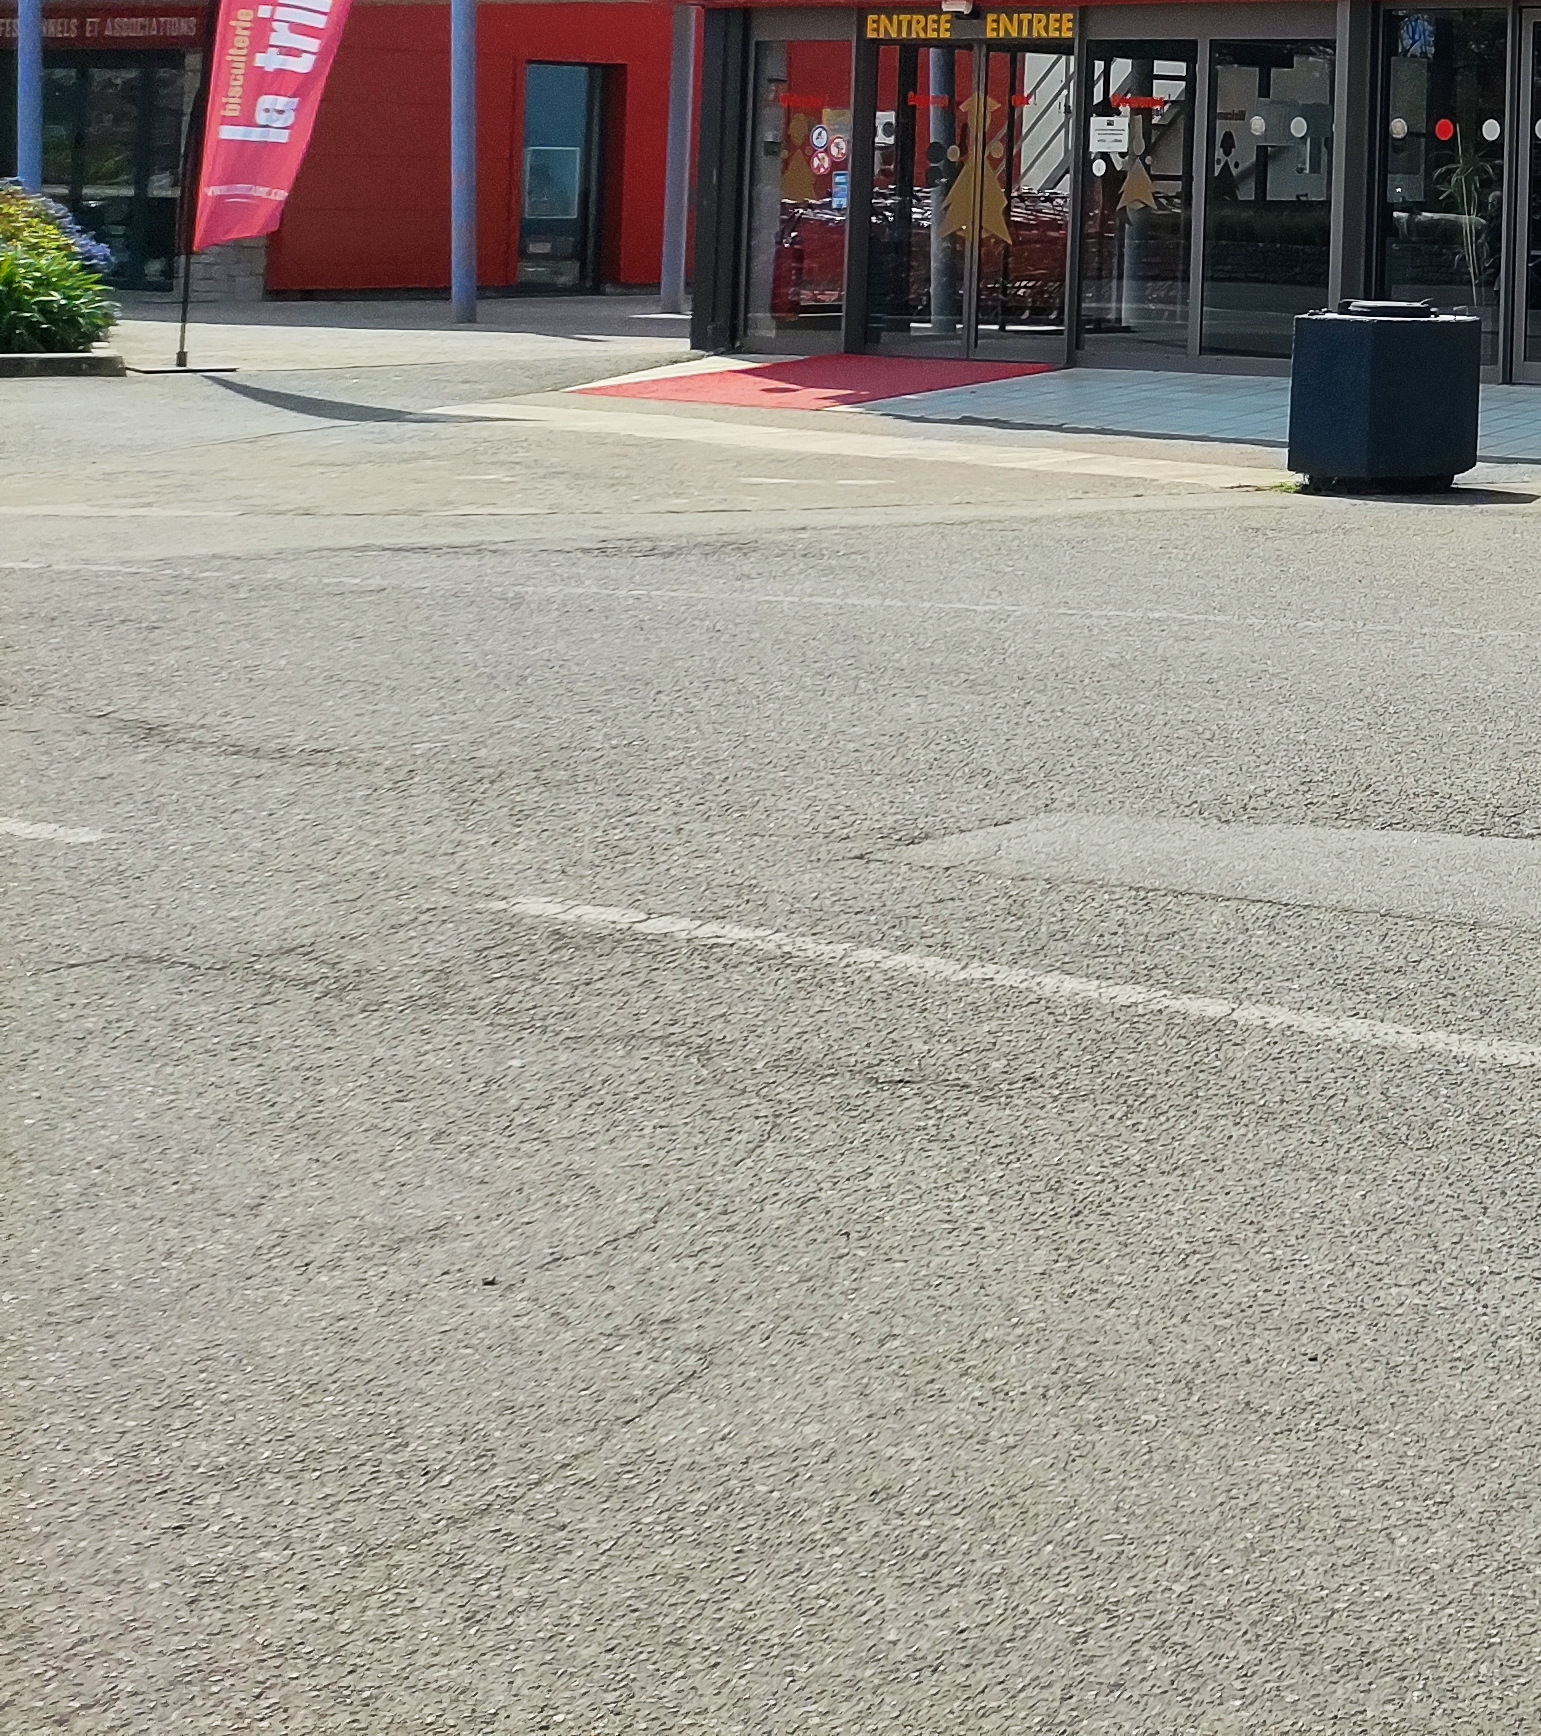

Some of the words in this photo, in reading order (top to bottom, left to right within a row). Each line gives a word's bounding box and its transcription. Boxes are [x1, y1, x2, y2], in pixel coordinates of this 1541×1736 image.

[866, 14, 951, 38] ENTREE
[986, 13, 1075, 38] ENTREE
[220, 8, 254, 118] biscuiterie
[218, 94, 300, 143] la
